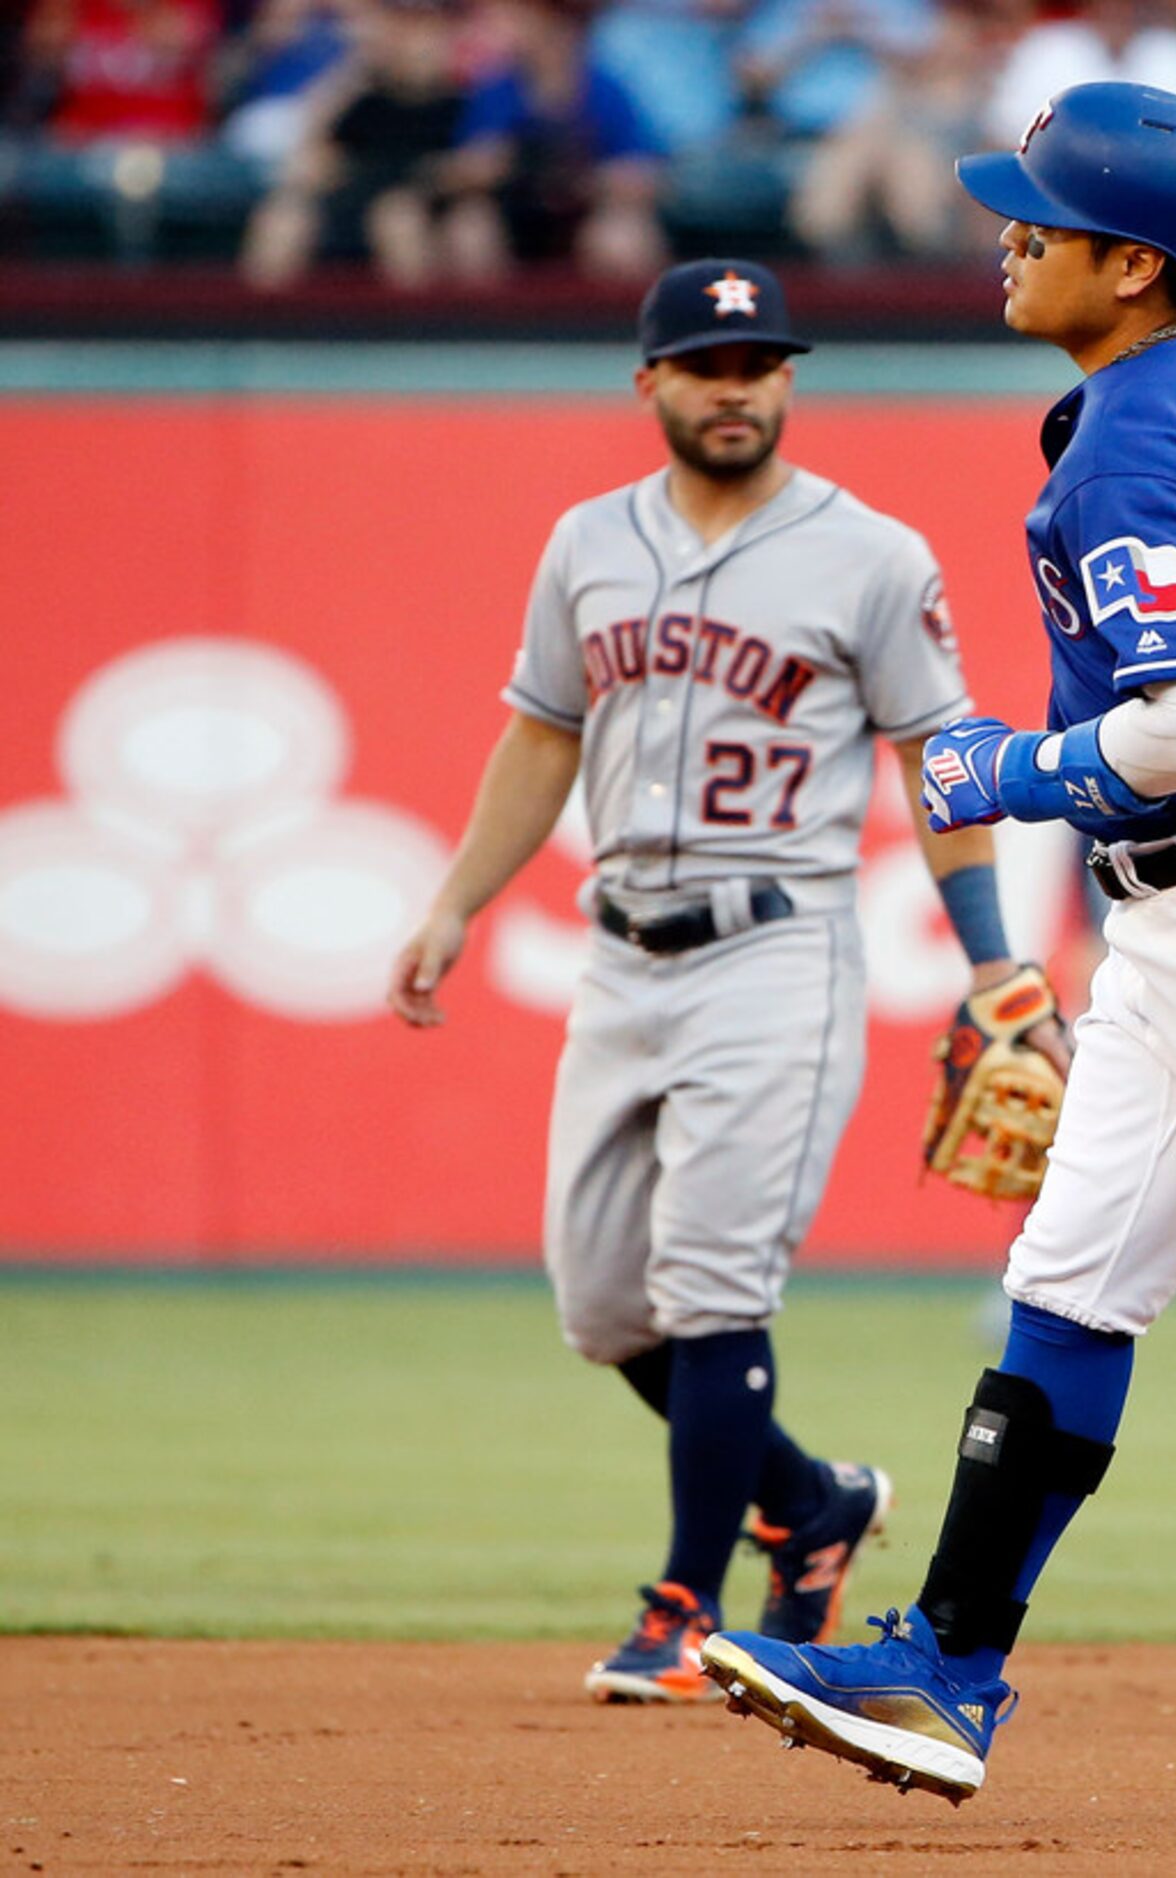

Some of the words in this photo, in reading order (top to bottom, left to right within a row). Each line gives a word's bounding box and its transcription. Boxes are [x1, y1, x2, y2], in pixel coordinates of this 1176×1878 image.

[581, 612, 816, 727] OUSTON
[701, 739, 812, 832] 27
[1064, 780, 1094, 809] 17
